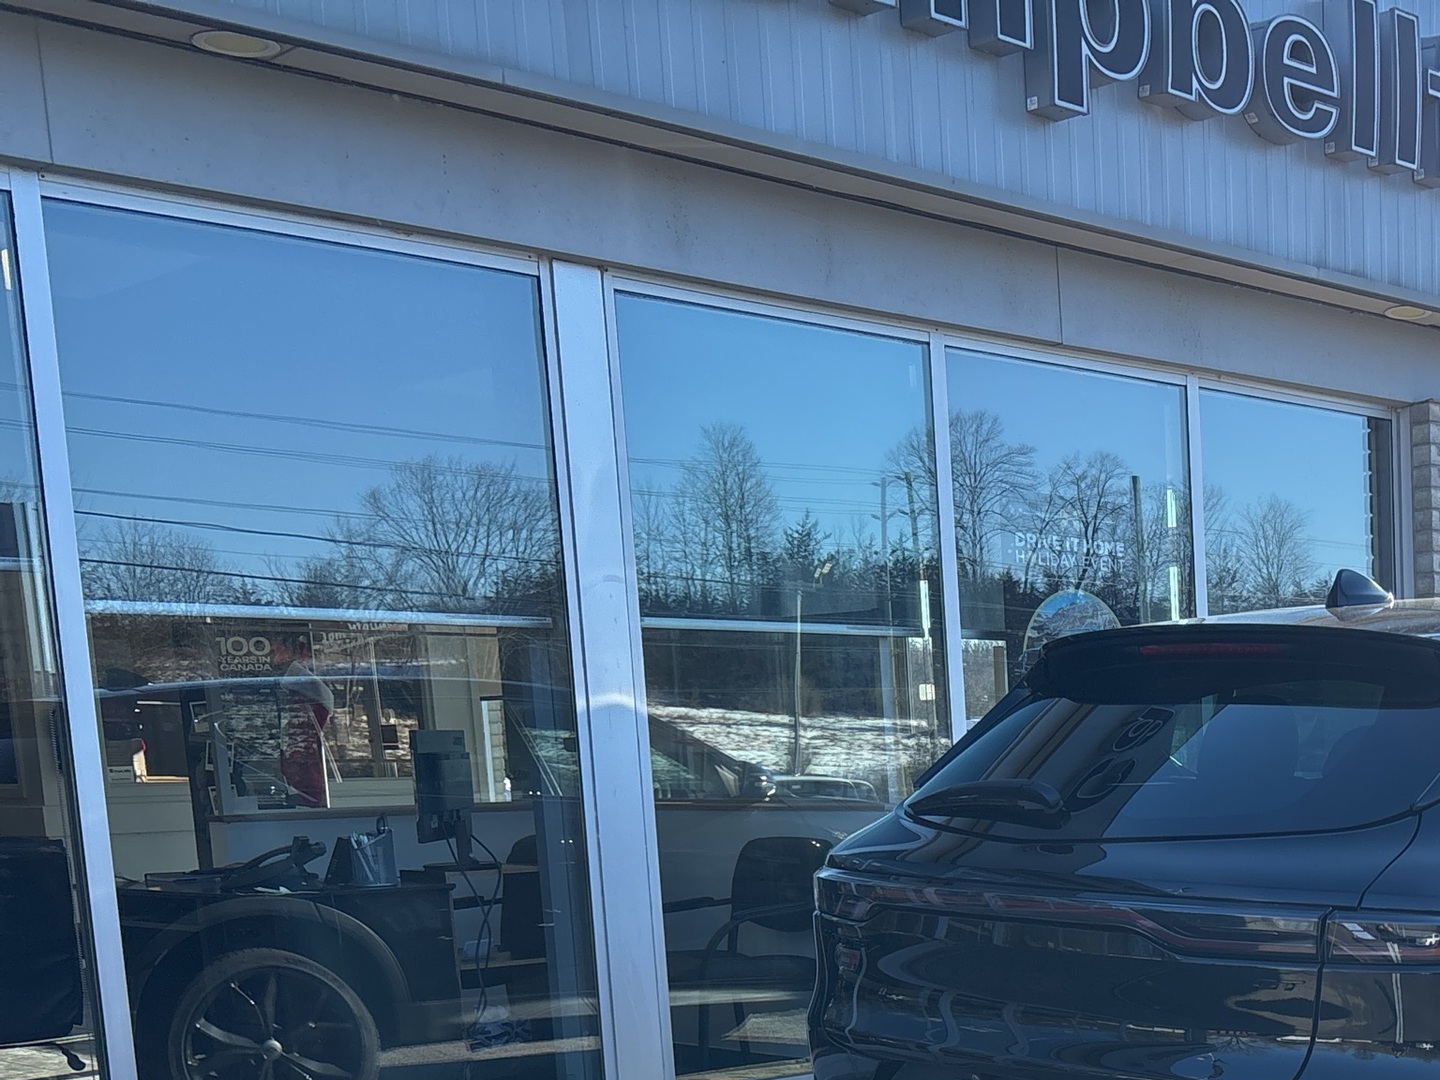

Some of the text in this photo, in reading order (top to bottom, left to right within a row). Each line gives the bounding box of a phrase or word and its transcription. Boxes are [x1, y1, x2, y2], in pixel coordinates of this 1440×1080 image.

[1066, 537, 1079, 552] IT
[215, 636, 271, 655] 100
[219, 656, 257, 664] YEARS
